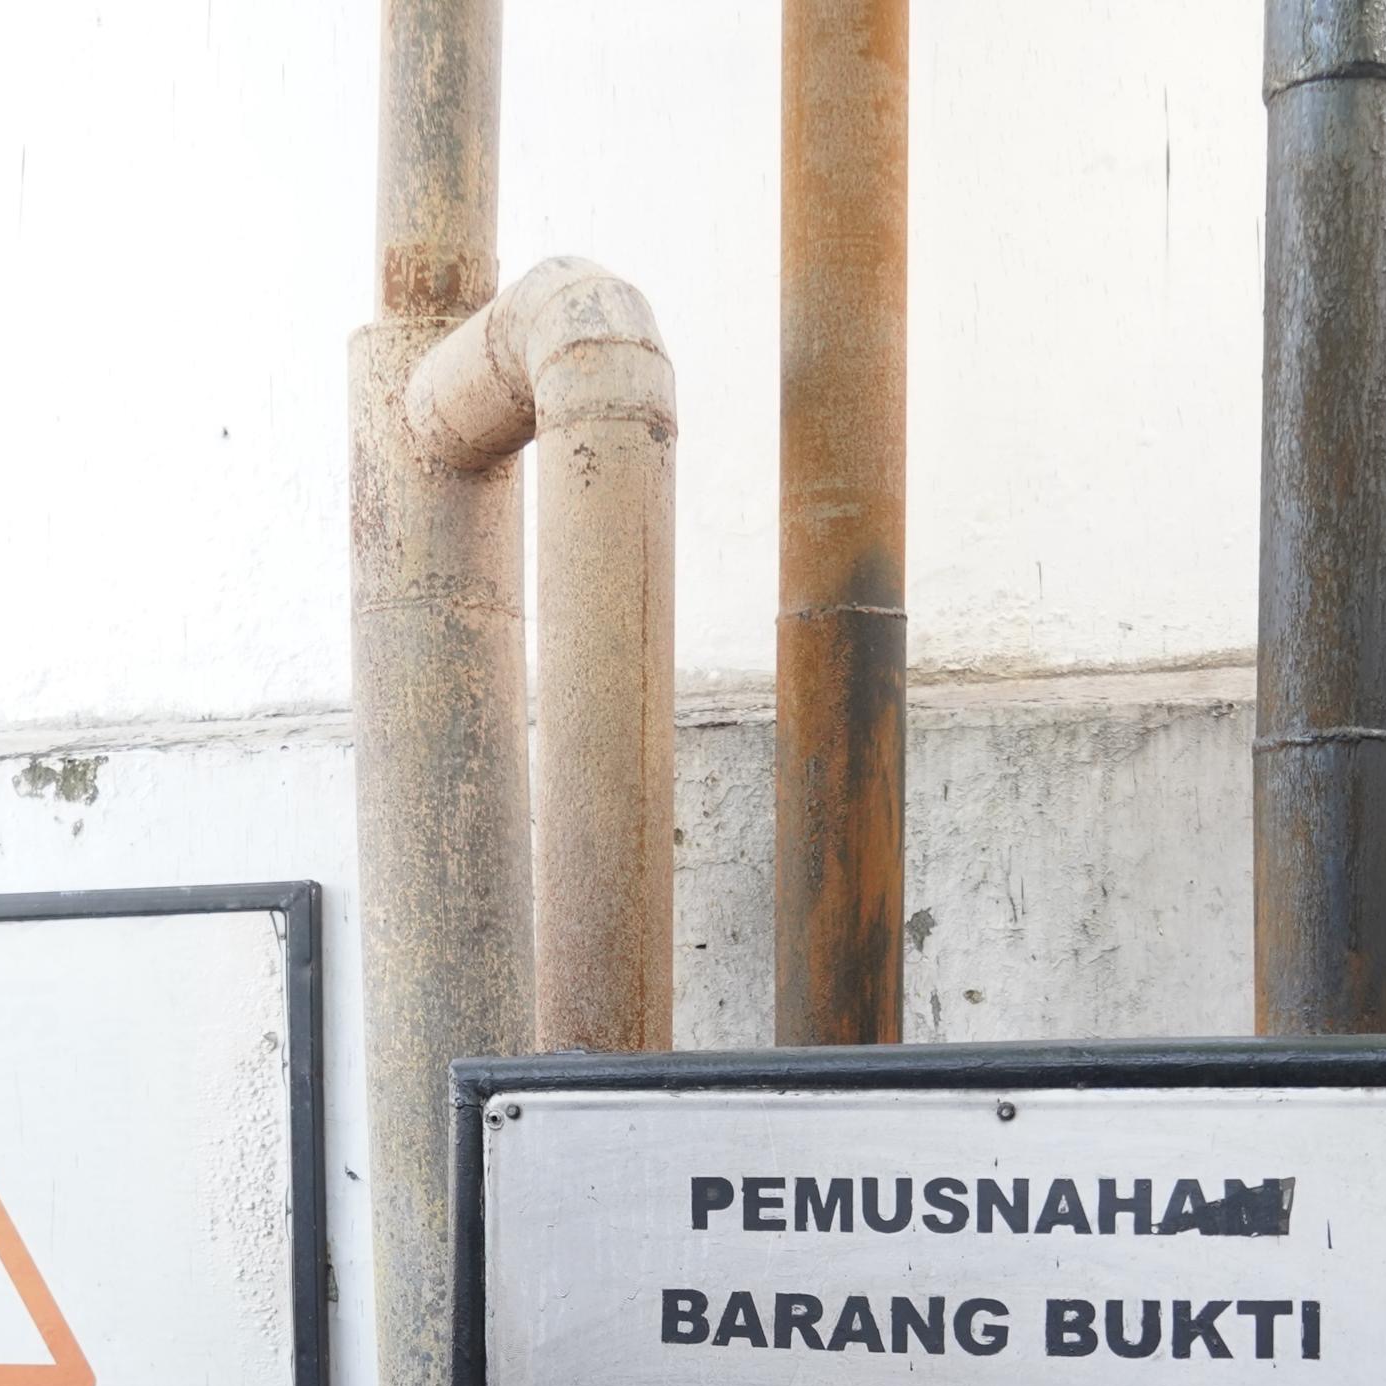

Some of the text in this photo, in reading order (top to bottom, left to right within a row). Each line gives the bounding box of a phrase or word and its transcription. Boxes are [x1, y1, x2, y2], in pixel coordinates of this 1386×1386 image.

[690, 1175, 1290, 1236] PEMUSNAHAN
[660, 1287, 1321, 1360] BARANG BUKTI
